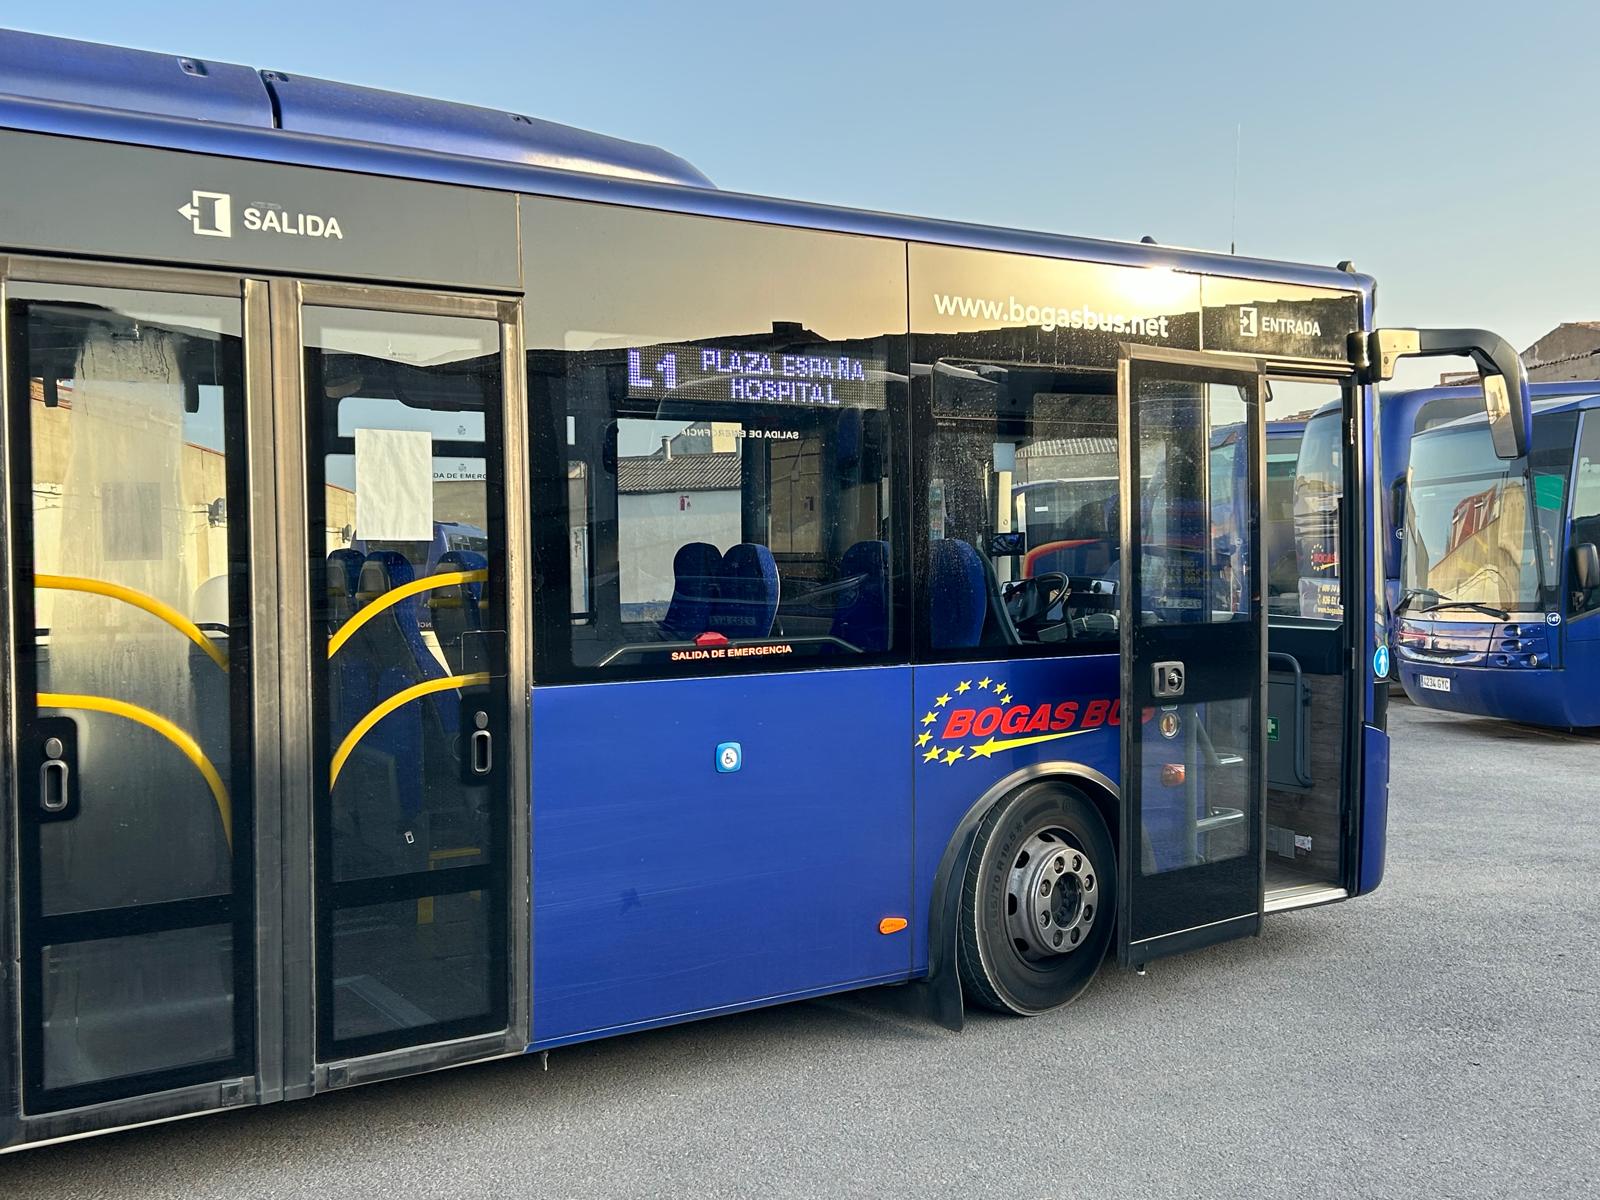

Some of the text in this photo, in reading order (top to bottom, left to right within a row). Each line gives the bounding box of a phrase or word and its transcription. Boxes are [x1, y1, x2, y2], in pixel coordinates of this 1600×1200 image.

[243, 207, 344, 240] SALIDA
[932, 293, 1169, 338] www.bogasbus.net
[1261, 315, 1322, 337] ENTRADA
[628, 349, 676, 389] L1
[702, 350, 865, 381] PLAZA ESPAÑA
[731, 378, 840, 405] HOSPITAL
[671, 645, 793, 661] SALIDA DE EMERGENCIA
[942, 701, 1078, 739] BOGAS
